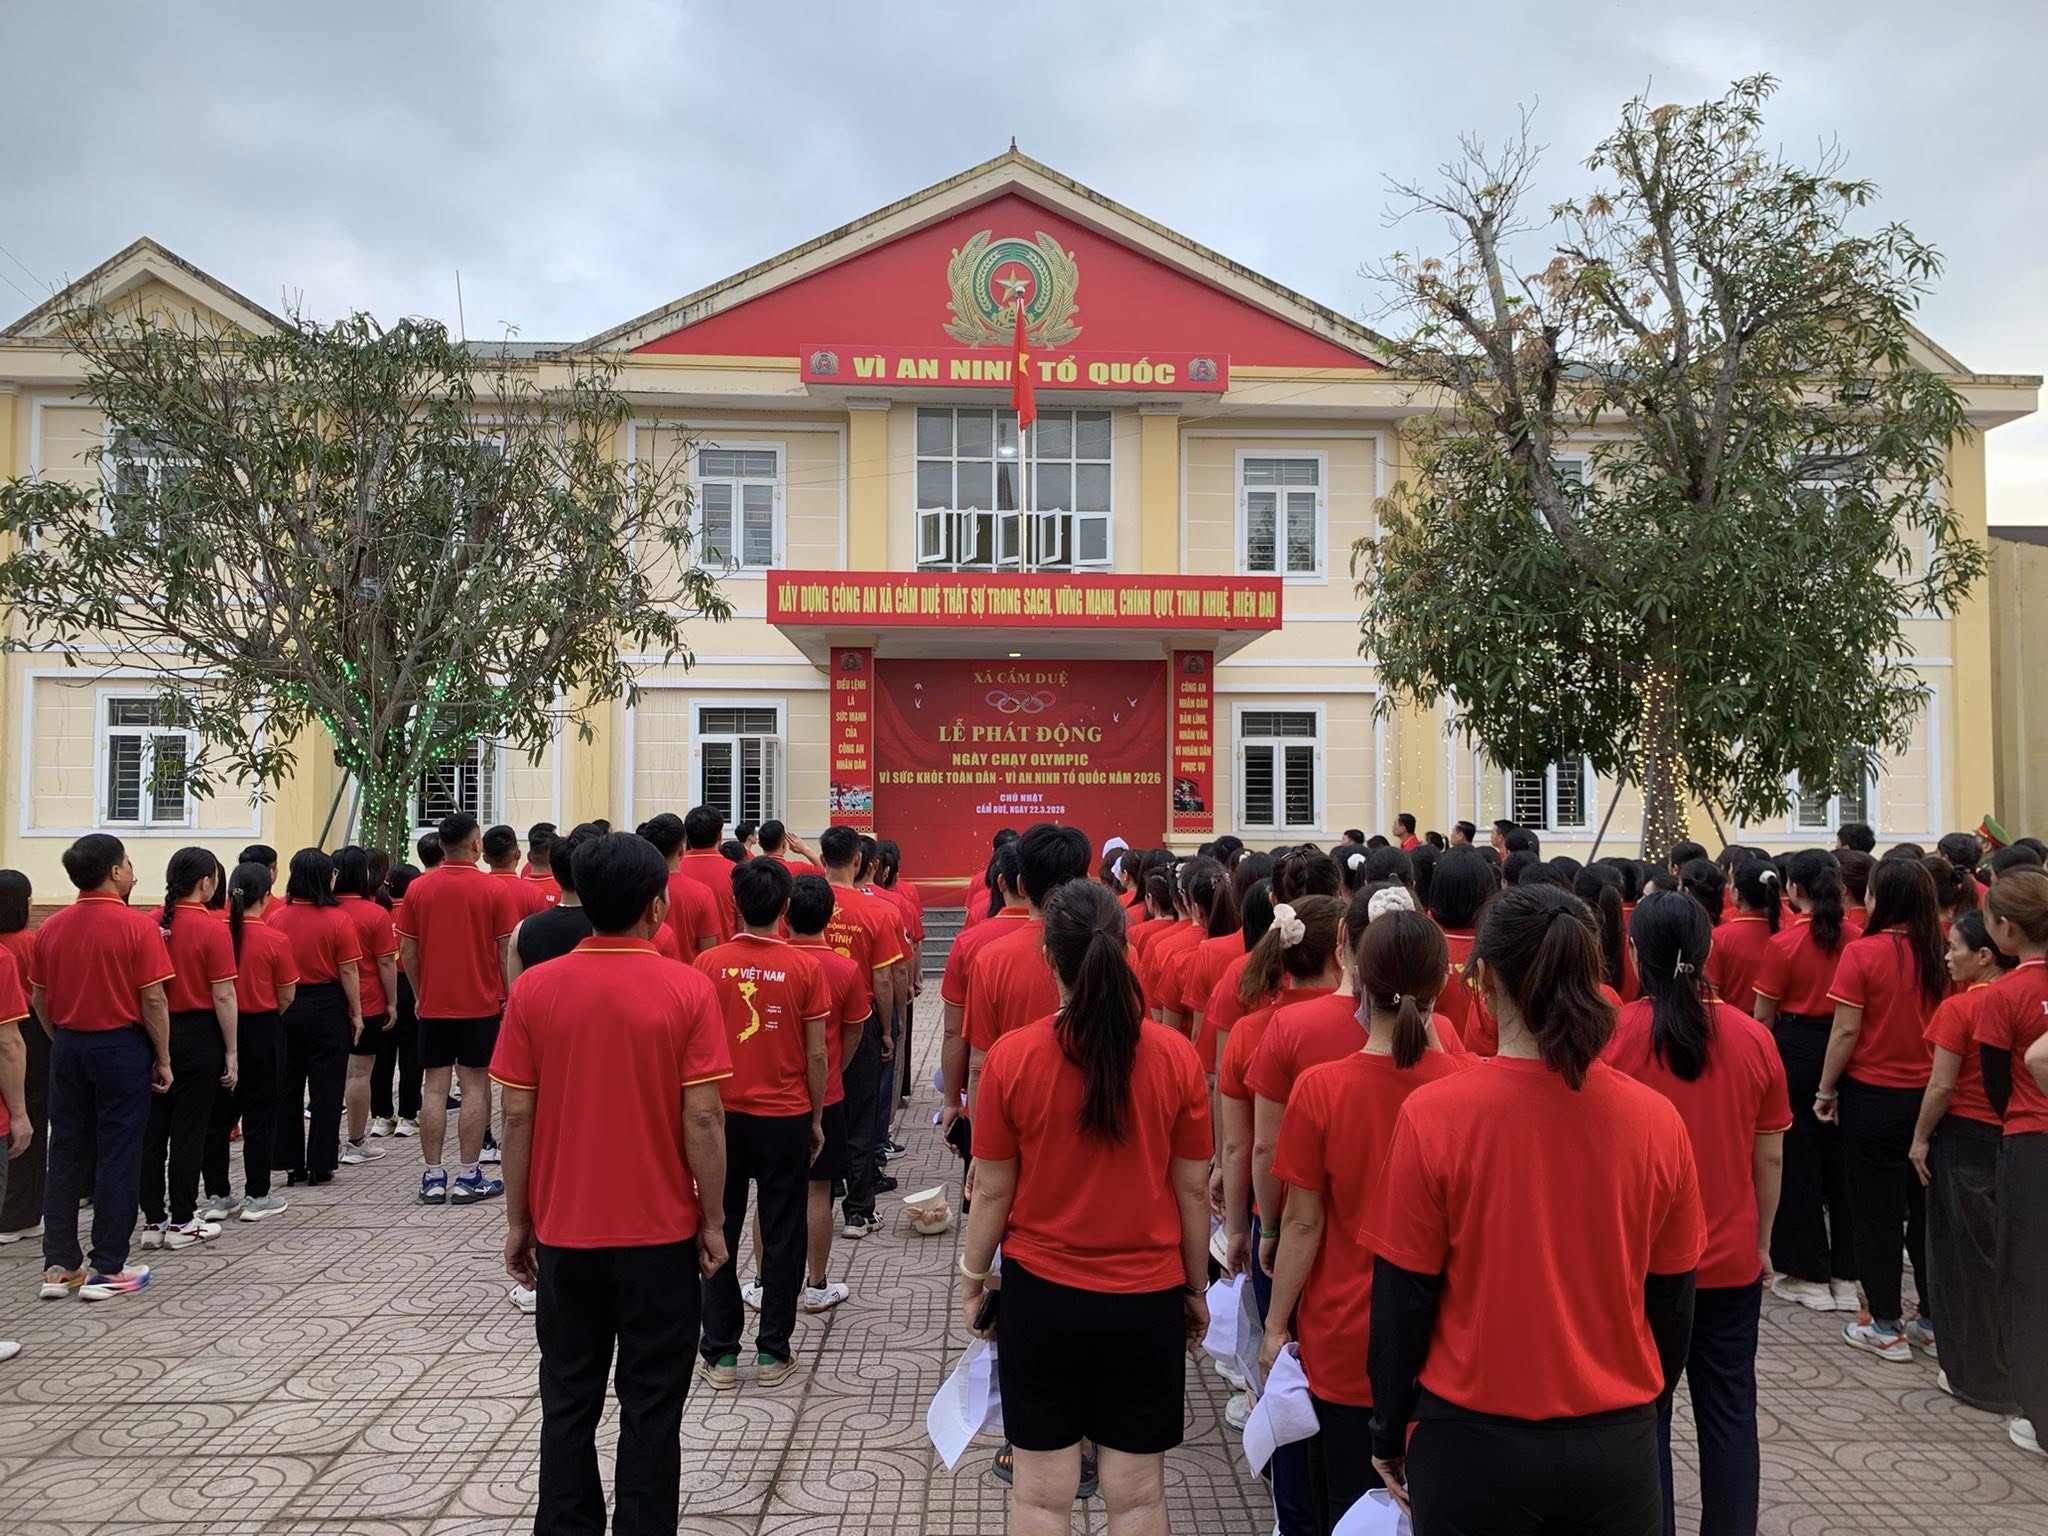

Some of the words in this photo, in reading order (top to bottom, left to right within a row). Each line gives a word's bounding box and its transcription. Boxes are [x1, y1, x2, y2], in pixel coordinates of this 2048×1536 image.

[853, 354, 886, 378] VÌ
[896, 358, 939, 379] AN
[1037, 355, 1077, 382] TỔ
[1089, 357, 1176, 385] QUỐC
[778, 581, 798, 612] XÂY
[801, 582, 829, 617] DỰNG
[832, 582, 860, 613] CÔNG
[863, 586, 876, 613] AN
[879, 583, 893, 614] XÃ
[895, 578, 918, 614] CẨM
[921, 583, 941, 618] DUỆ
[943, 583, 968, 619] THẬT
[971, 584, 987, 619] SỰ
[988, 587, 1021, 615] TRONG
[1024, 587, 1053, 620] SẠCH,
[1055, 585, 1083, 616] VỮNG
[1086, 588, 1117, 620] MẠNH,
[1120, 585, 1151, 616] CHÍNH
[1153, 589, 1174, 618] QUY,
[1176, 590, 1200, 617] TINH
[1233, 586, 1256, 622] HIỆN
[1258, 591, 1276, 623] ĐẠI
[974, 669, 993, 684] XÃ
[997, 667, 1031, 684] CẨM
[1035, 670, 1068, 687] DUỆ
[938, 718, 966, 742] LỄ
[971, 721, 1031, 742] PHÁT
[1036, 722, 1102, 748] ĐỘNG
[855, 743, 865, 754] AN
[952, 752, 988, 766] NGÀY
[991, 753, 1027, 768] CHẠY
[1030, 753, 1089, 766] OLYMPIC
[879, 769, 890, 784] VÌ
[892, 769, 914, 784] SỨC
[916, 769, 944, 784] KHỎE
[946, 770, 973, 784] TOÀN
[975, 770, 996, 784] DÂN
[1005, 770, 1017, 784] VÌ
[1078, 768, 1107, 785] QUỐC
[1108, 770, 1132, 784] NĂM
[1134, 772, 1161, 785] 2026
[1000, 792, 1018, 802] CHỦ
[1010, 804, 1029, 814] NGÀY
[829, 932, 853, 944] TĨNH
[721, 968, 727, 979] I
[740, 966, 762, 981] VIỆT
[763, 970, 785, 982] NAM
